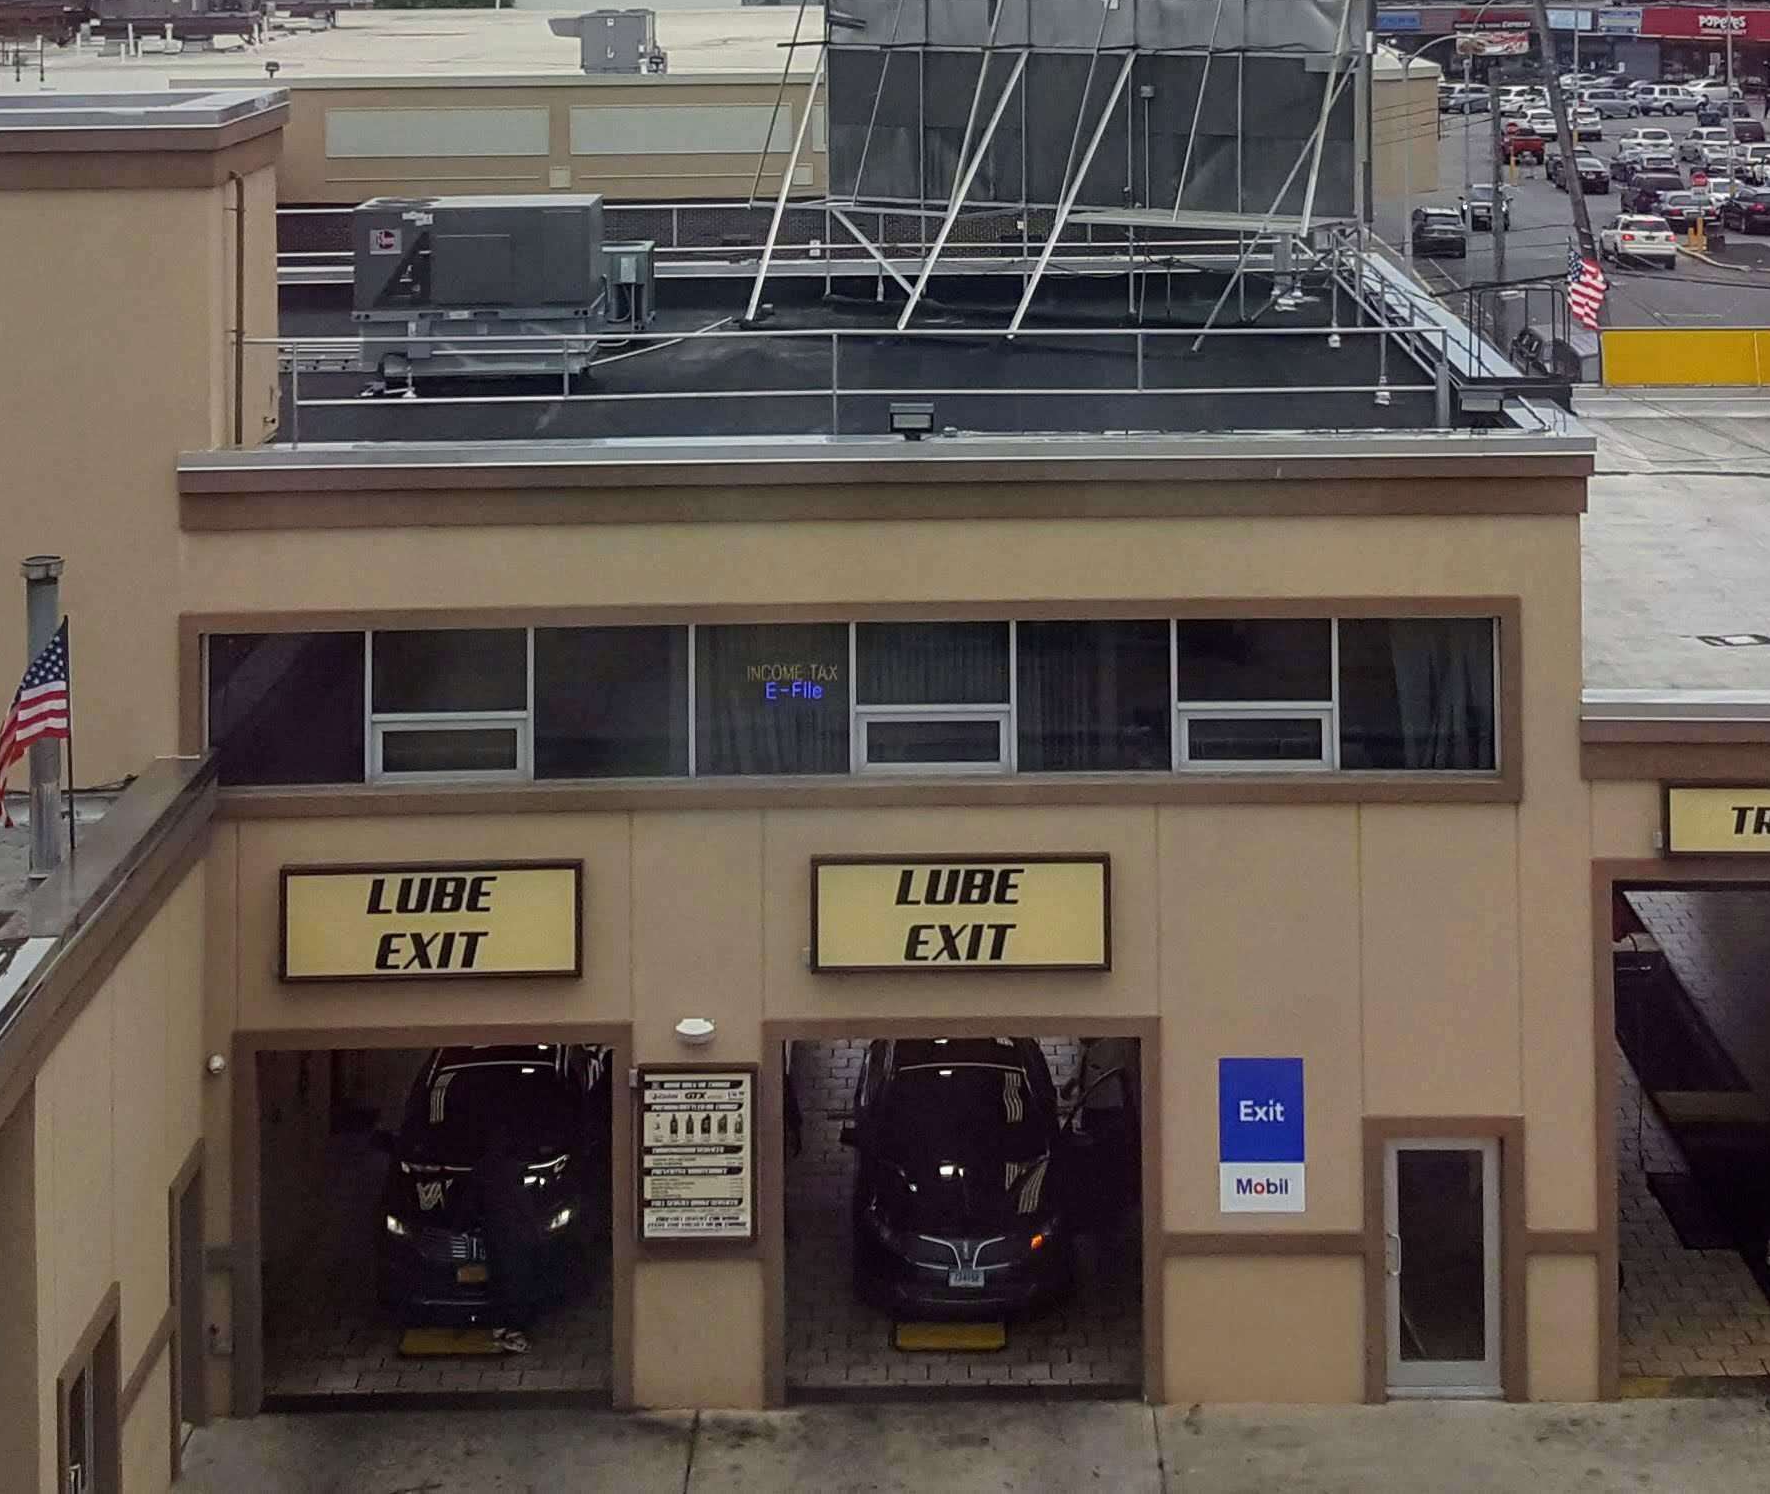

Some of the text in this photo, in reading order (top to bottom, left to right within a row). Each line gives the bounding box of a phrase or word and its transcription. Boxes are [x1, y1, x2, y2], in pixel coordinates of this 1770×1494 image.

[747, 664, 838, 681] INCOME TAX
[366, 876, 498, 915] LUBE
[895, 868, 1025, 906] LUBE
[374, 931, 489, 970] EXIT
[903, 923, 1017, 961] EXIT
[684, 1091, 707, 1100] GTX
[1239, 1099, 1285, 1122] Exit
[1236, 1178, 1289, 1195] Mobil
